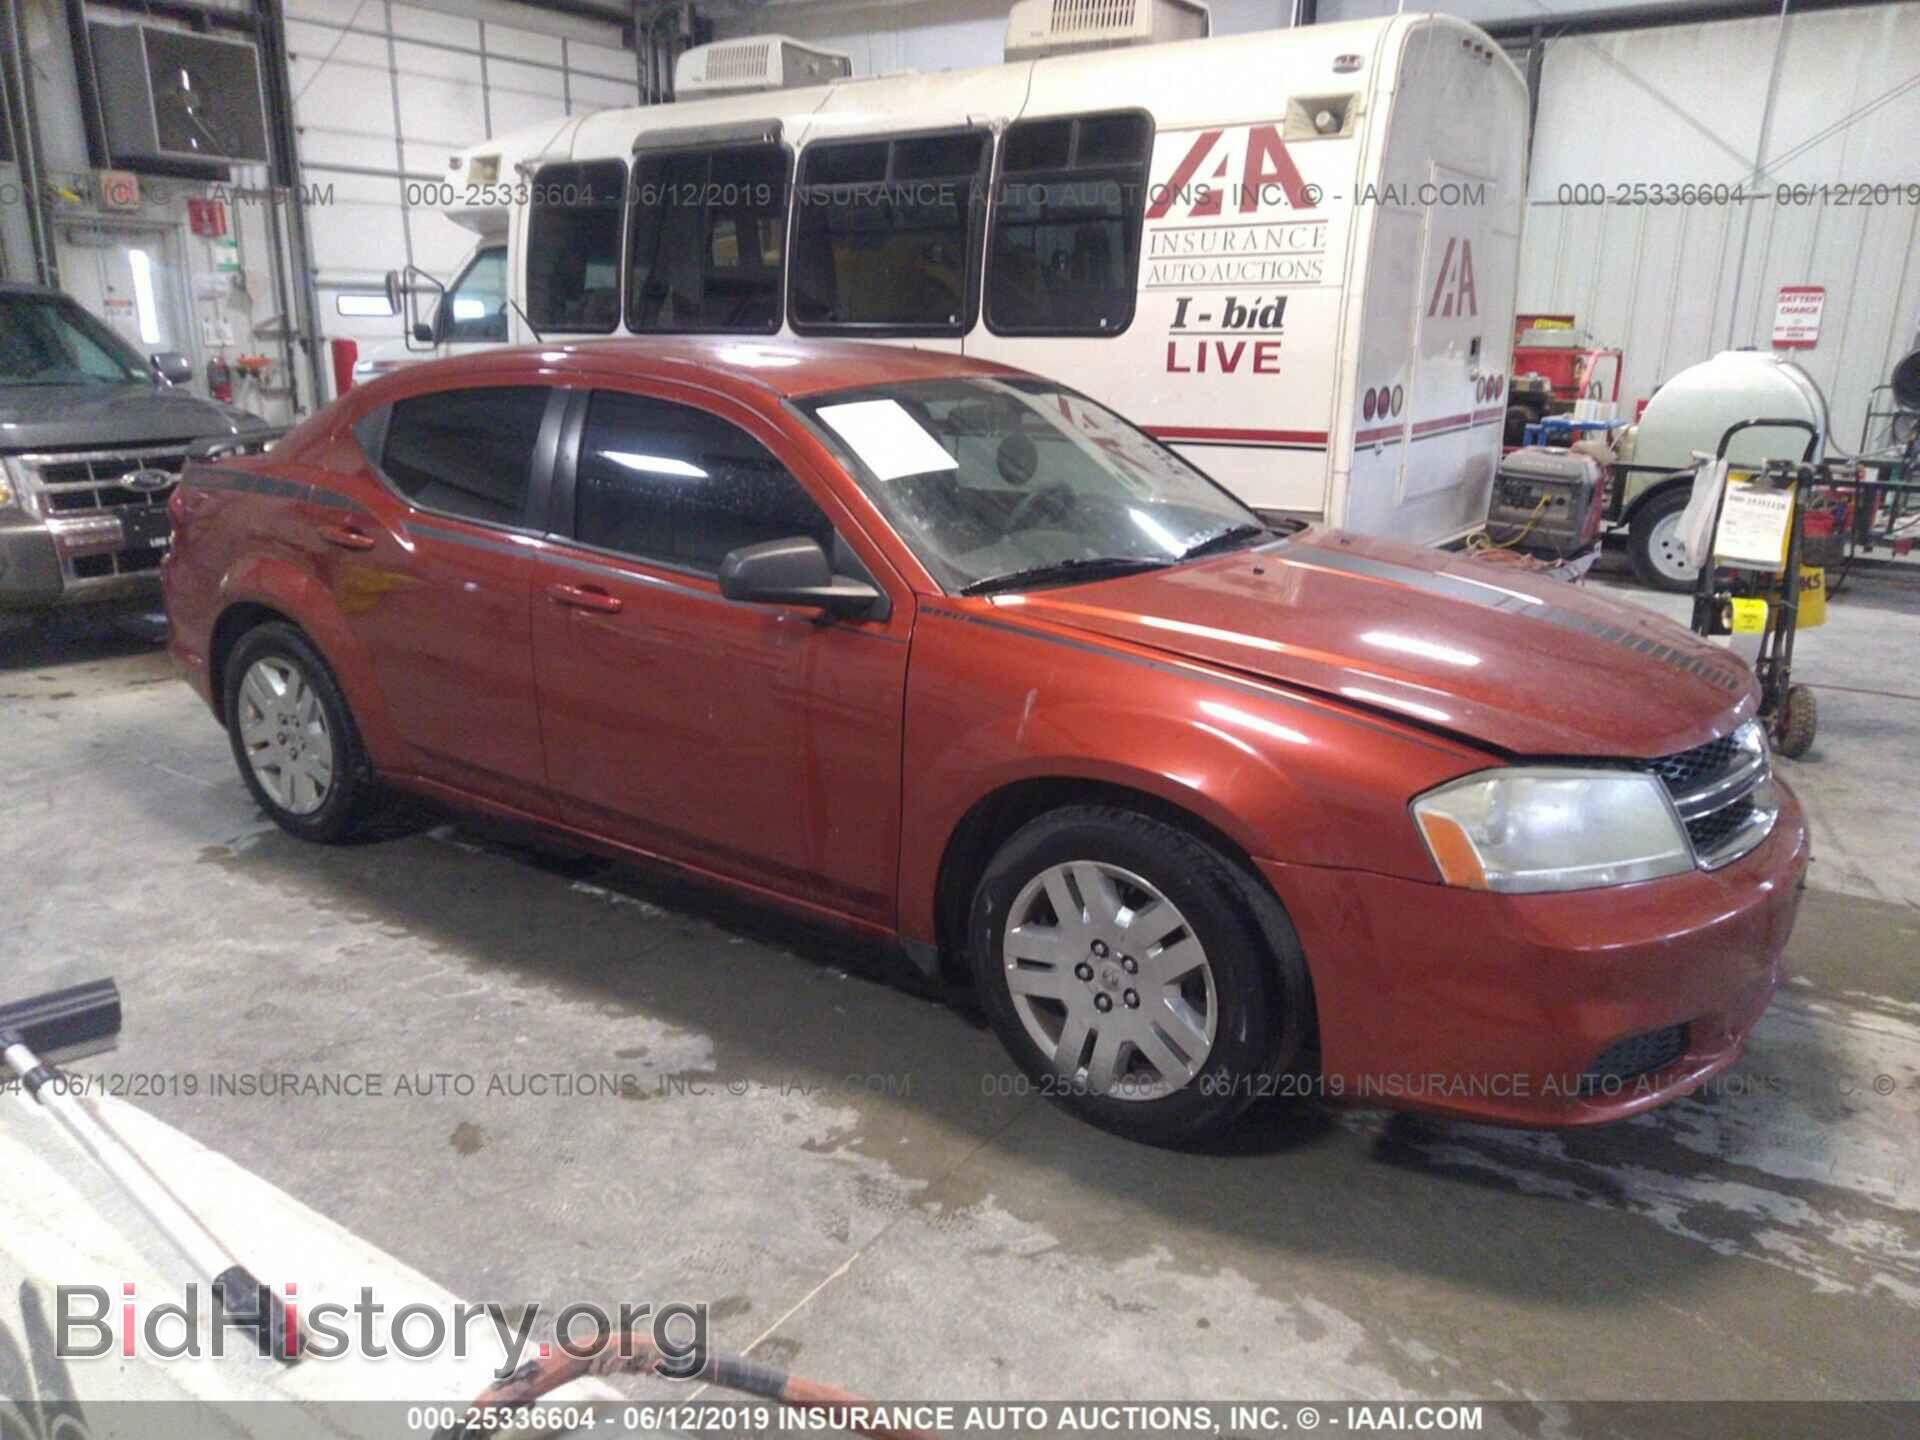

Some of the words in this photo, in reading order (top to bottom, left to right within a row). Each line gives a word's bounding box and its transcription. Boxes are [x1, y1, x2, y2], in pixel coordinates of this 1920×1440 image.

[1150, 226, 1328, 255] INSURANCE
[1148, 263, 1206, 283] AUTO
[1210, 258, 1324, 282] AUCTIONS
[1166, 341, 1282, 374] LIVE
